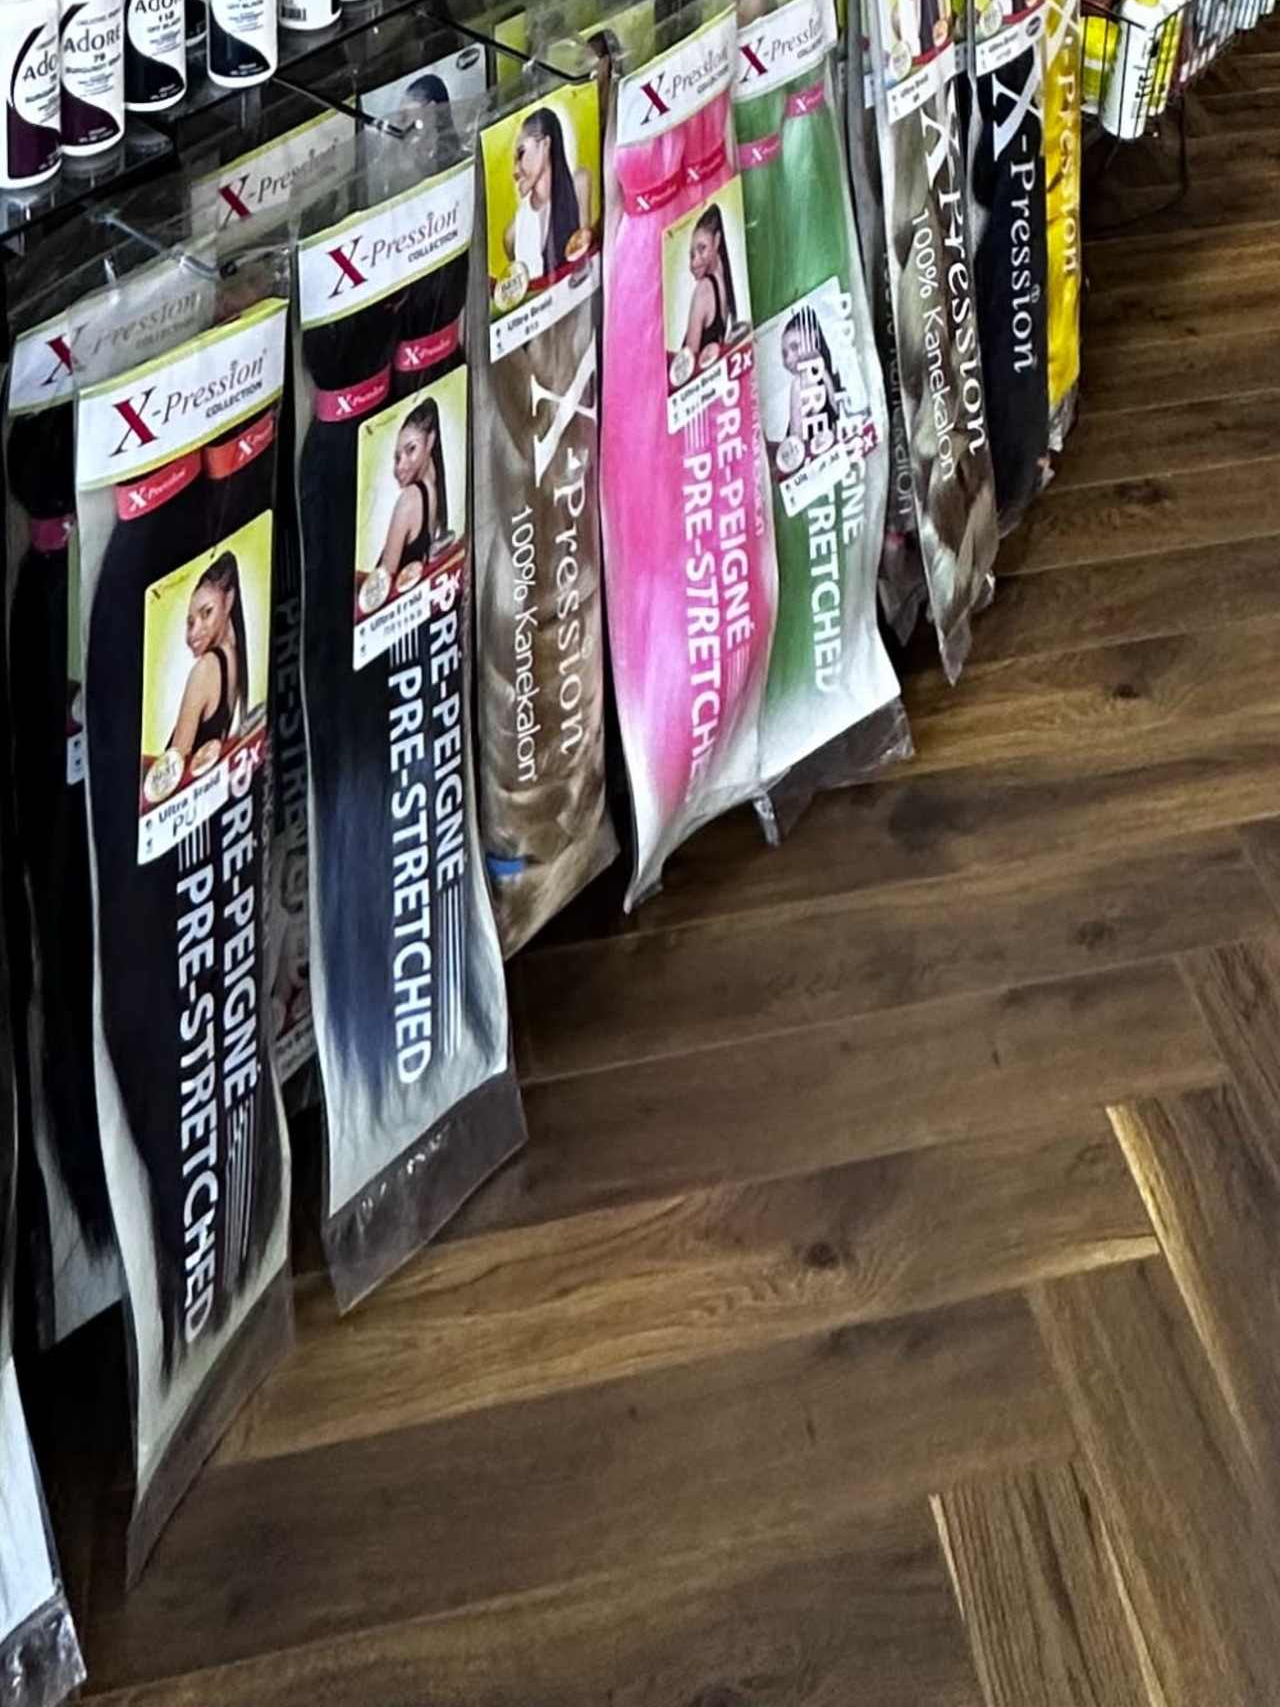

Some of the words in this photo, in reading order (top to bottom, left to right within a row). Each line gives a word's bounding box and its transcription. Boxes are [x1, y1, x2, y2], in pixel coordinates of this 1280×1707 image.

[327, 205, 458, 299] X-Pression
[407, 229, 459, 264] COLLECTION
[991, 71, 1045, 375] X-Pression
[109, 351, 268, 458] X-Pression
[205, 379, 263, 419] COLLECTION
[921, 303, 958, 484] Kanekalon
[510, 505, 538, 603] 100%
[530, 339, 600, 757] X-Pression
[513, 604, 543, 784] Kanekalon
[387, 665, 432, 1086] PRE-STRETCHED
[176, 863, 220, 1343] PRE-STRETCHED
